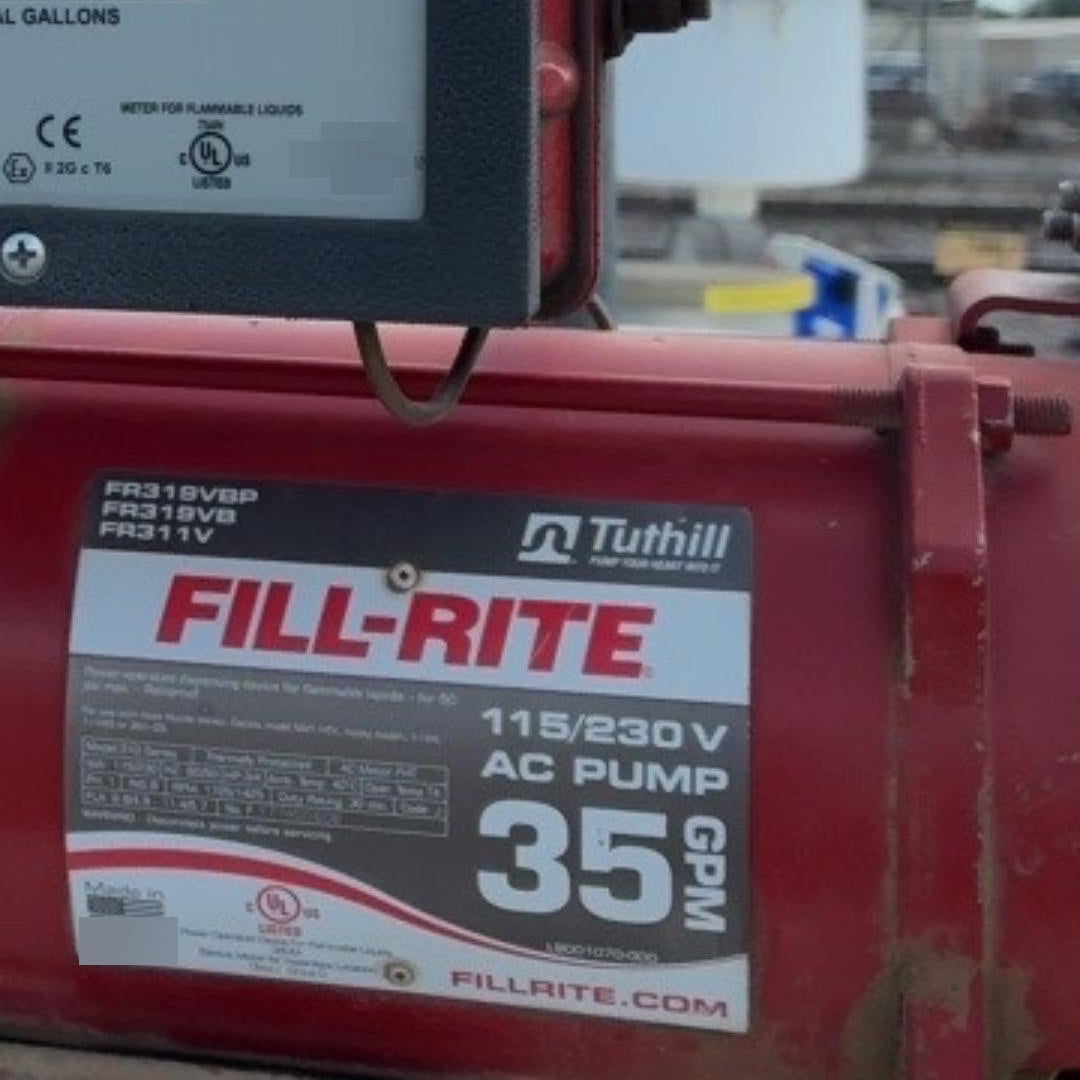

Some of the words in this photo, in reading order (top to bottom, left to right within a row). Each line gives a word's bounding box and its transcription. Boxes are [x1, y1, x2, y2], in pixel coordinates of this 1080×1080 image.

[21, 7, 121, 26] GALLONS
[120, 101, 159, 115] METER
[161, 102, 183, 115] FOR
[186, 102, 255, 116] FLAMMABLE
[258, 103, 304, 117] LIQUIDS
[36, 113, 82, 149] CE
[101, 500, 238, 525] FR319VB
[104, 479, 260, 505] FR319VBP
[98, 521, 216, 544] FR311V
[589, 516, 731, 559] Tuthill
[155, 573, 656, 679] FILL-RITE
[481, 706, 684, 749] 115/230
[691, 721, 729, 753] V
[480, 749, 556, 784] AC
[572, 757, 730, 796] PUMP
[476, 798, 674, 926] 35
[682, 814, 728, 934] GPM
[450, 969, 729, 1019] FILLRITE.COM
